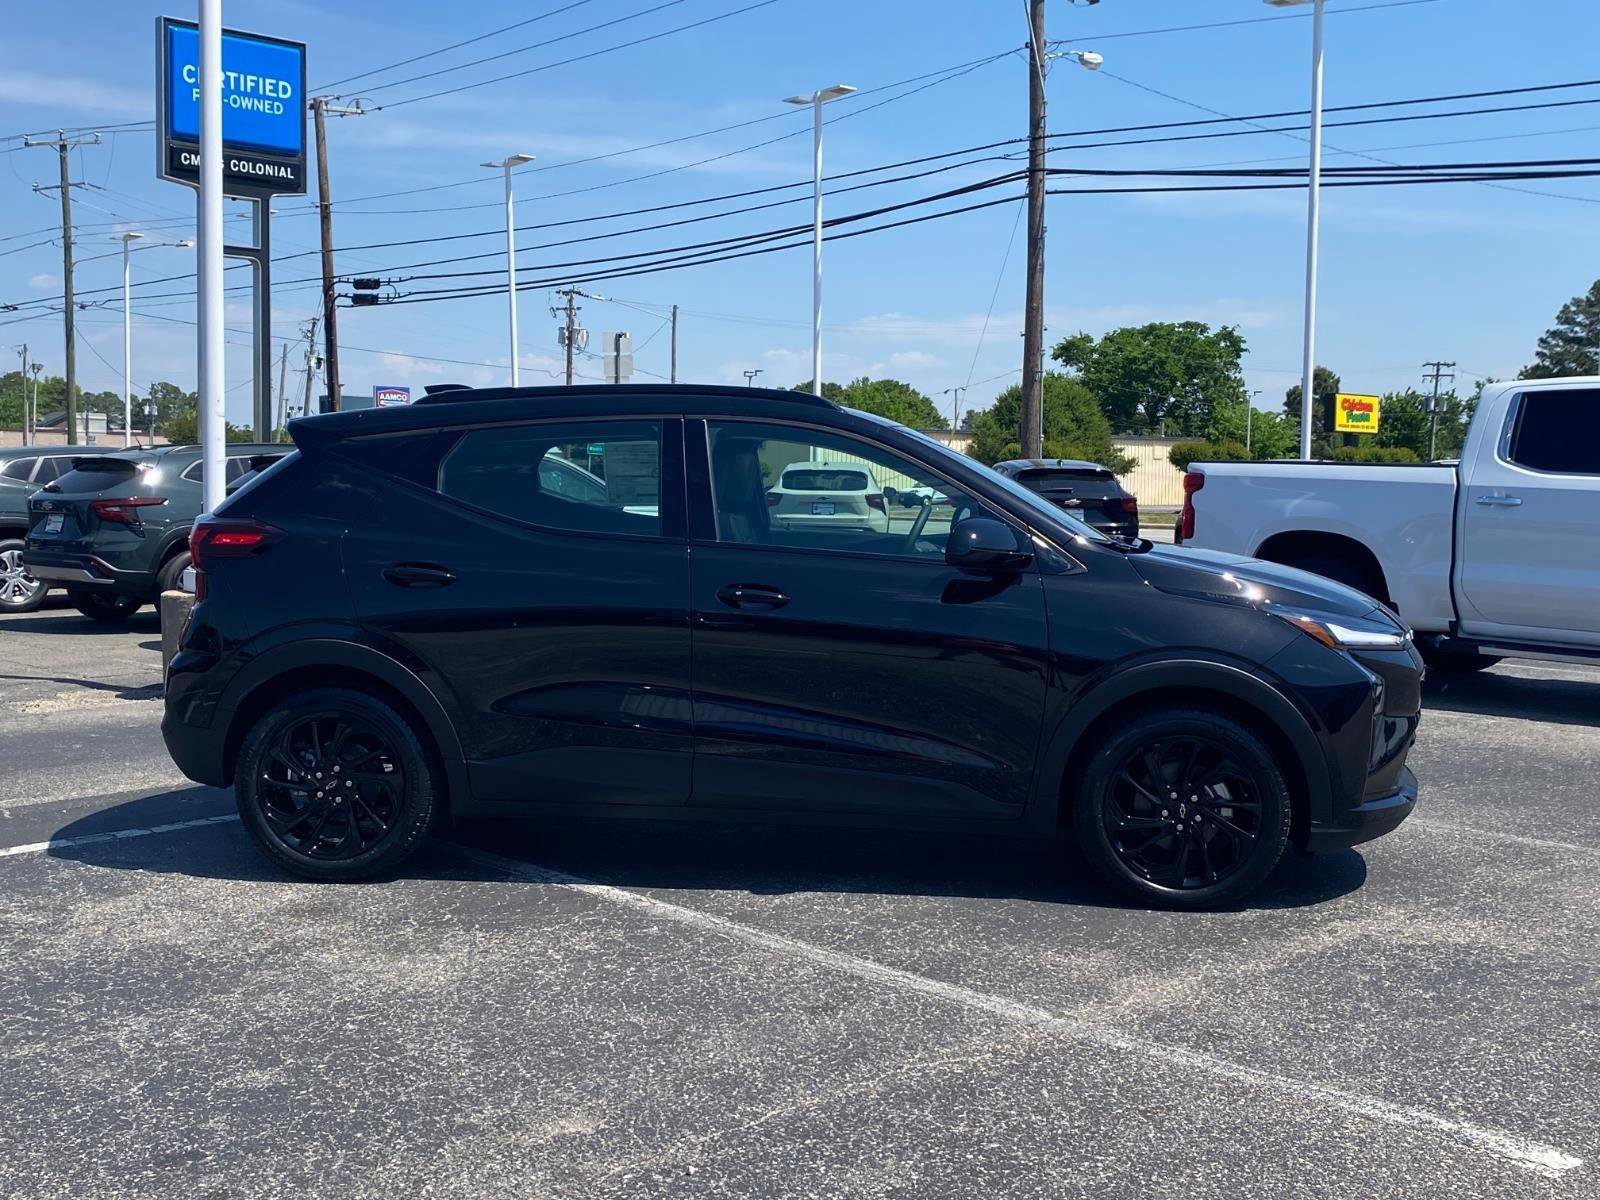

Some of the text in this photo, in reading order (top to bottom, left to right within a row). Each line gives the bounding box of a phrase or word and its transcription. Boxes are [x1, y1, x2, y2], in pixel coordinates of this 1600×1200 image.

[183, 64, 292, 99] CTIFIED
[192, 88, 284, 115] P-OWNED
[230, 159, 295, 179] COLONIAL
[380, 393, 407, 402] AAMCO
